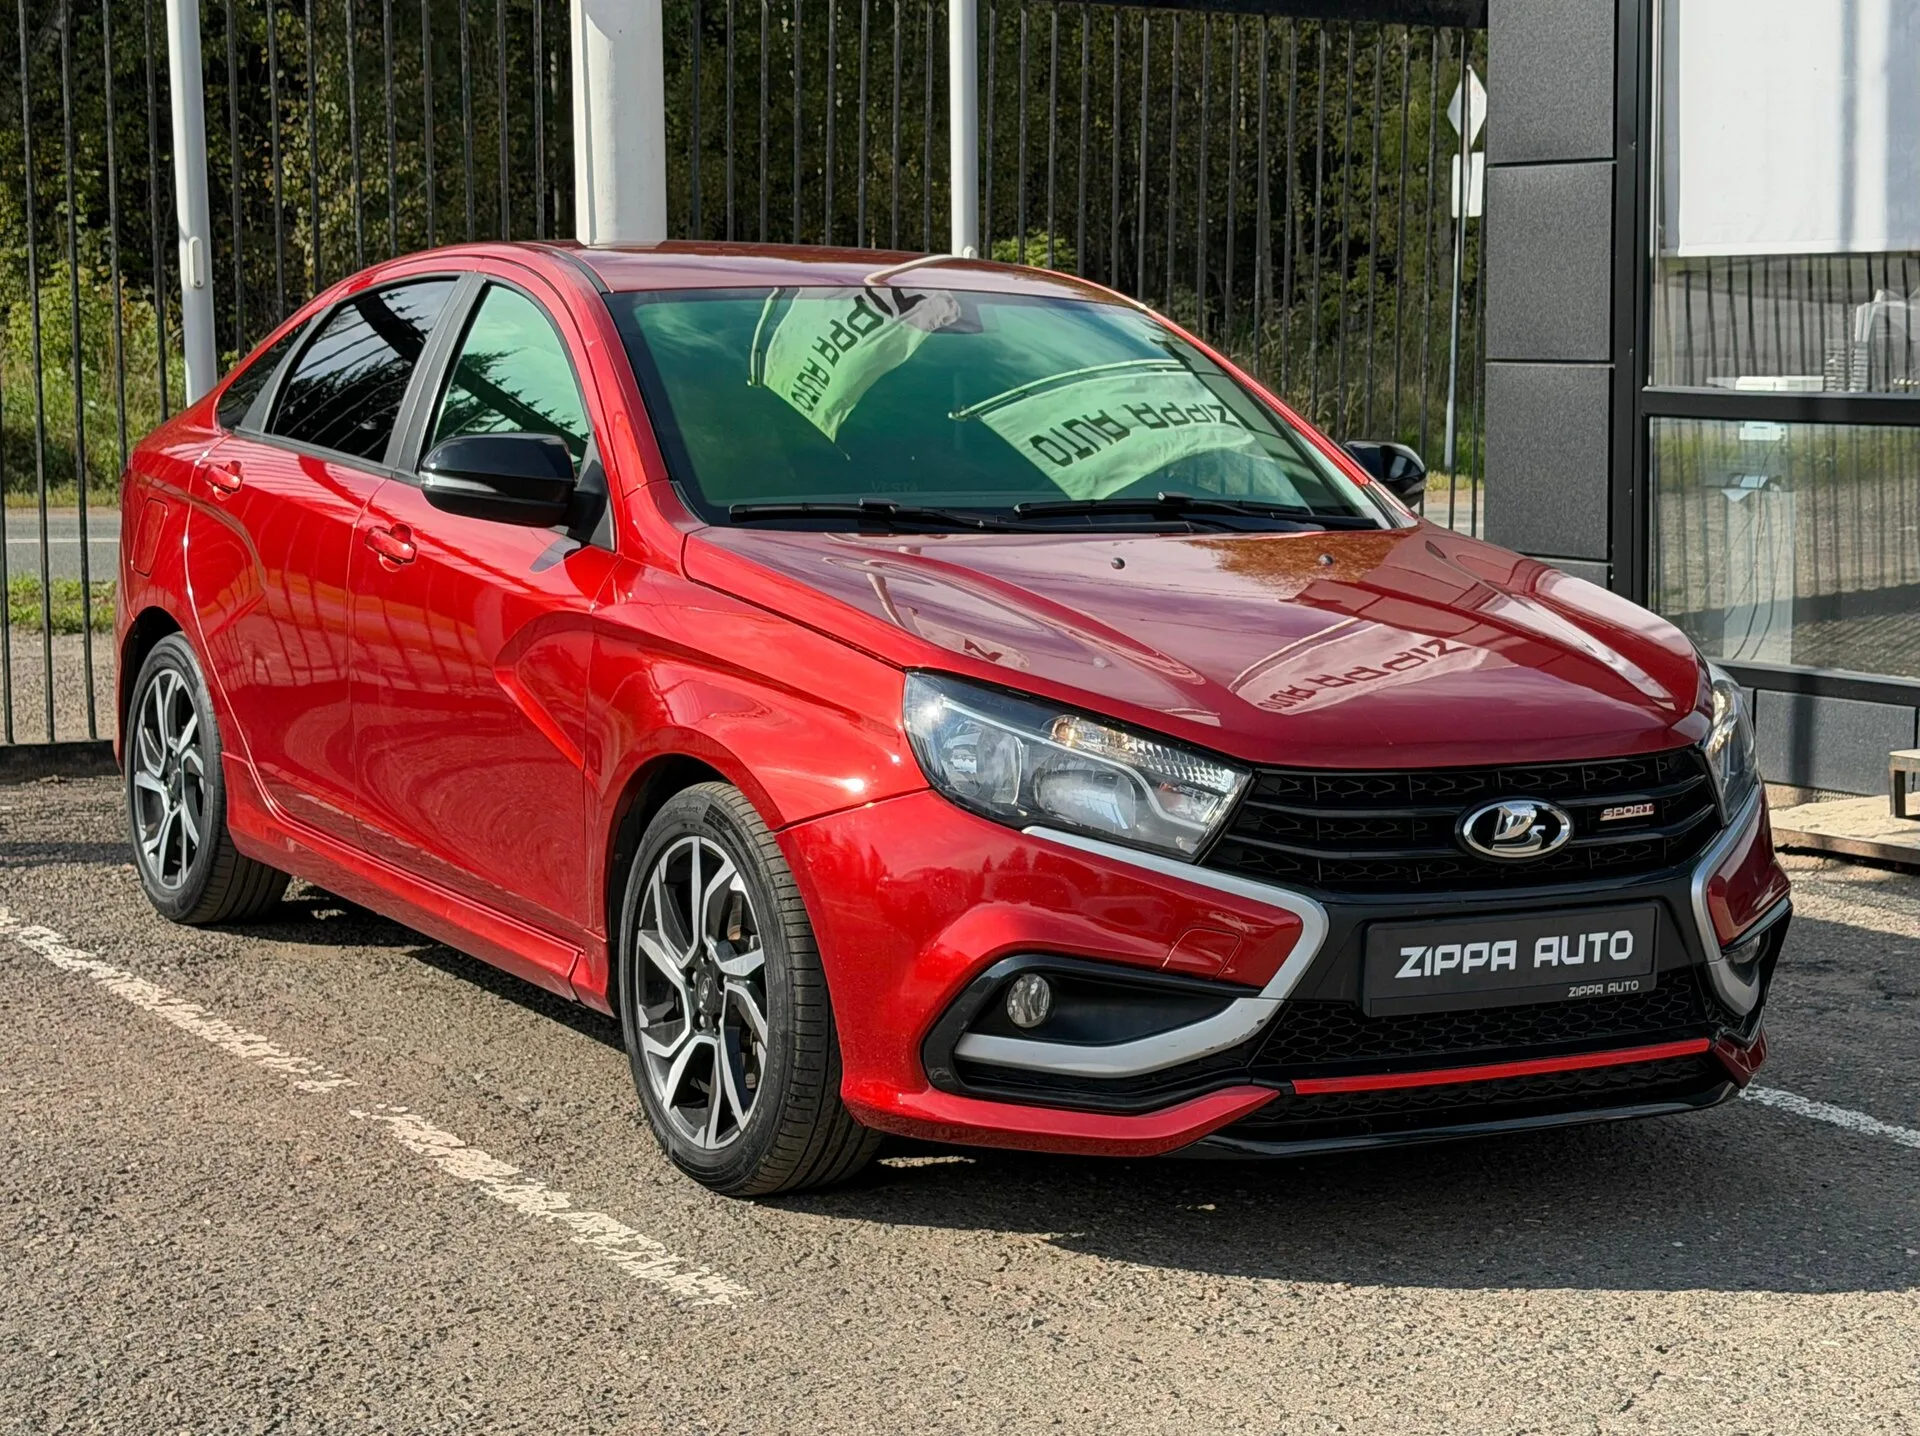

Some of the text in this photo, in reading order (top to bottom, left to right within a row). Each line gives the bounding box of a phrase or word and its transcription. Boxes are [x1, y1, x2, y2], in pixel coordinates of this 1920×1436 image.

[1029, 402, 1243, 467] ZIPPA AUTO
[1305, 639, 1471, 688] ZIPPA
[1600, 803, 1654, 820] SPORT
[1394, 930, 1634, 979] ZIPPA AUTO
[1567, 980, 1639, 998] ZIPPA AUTO
